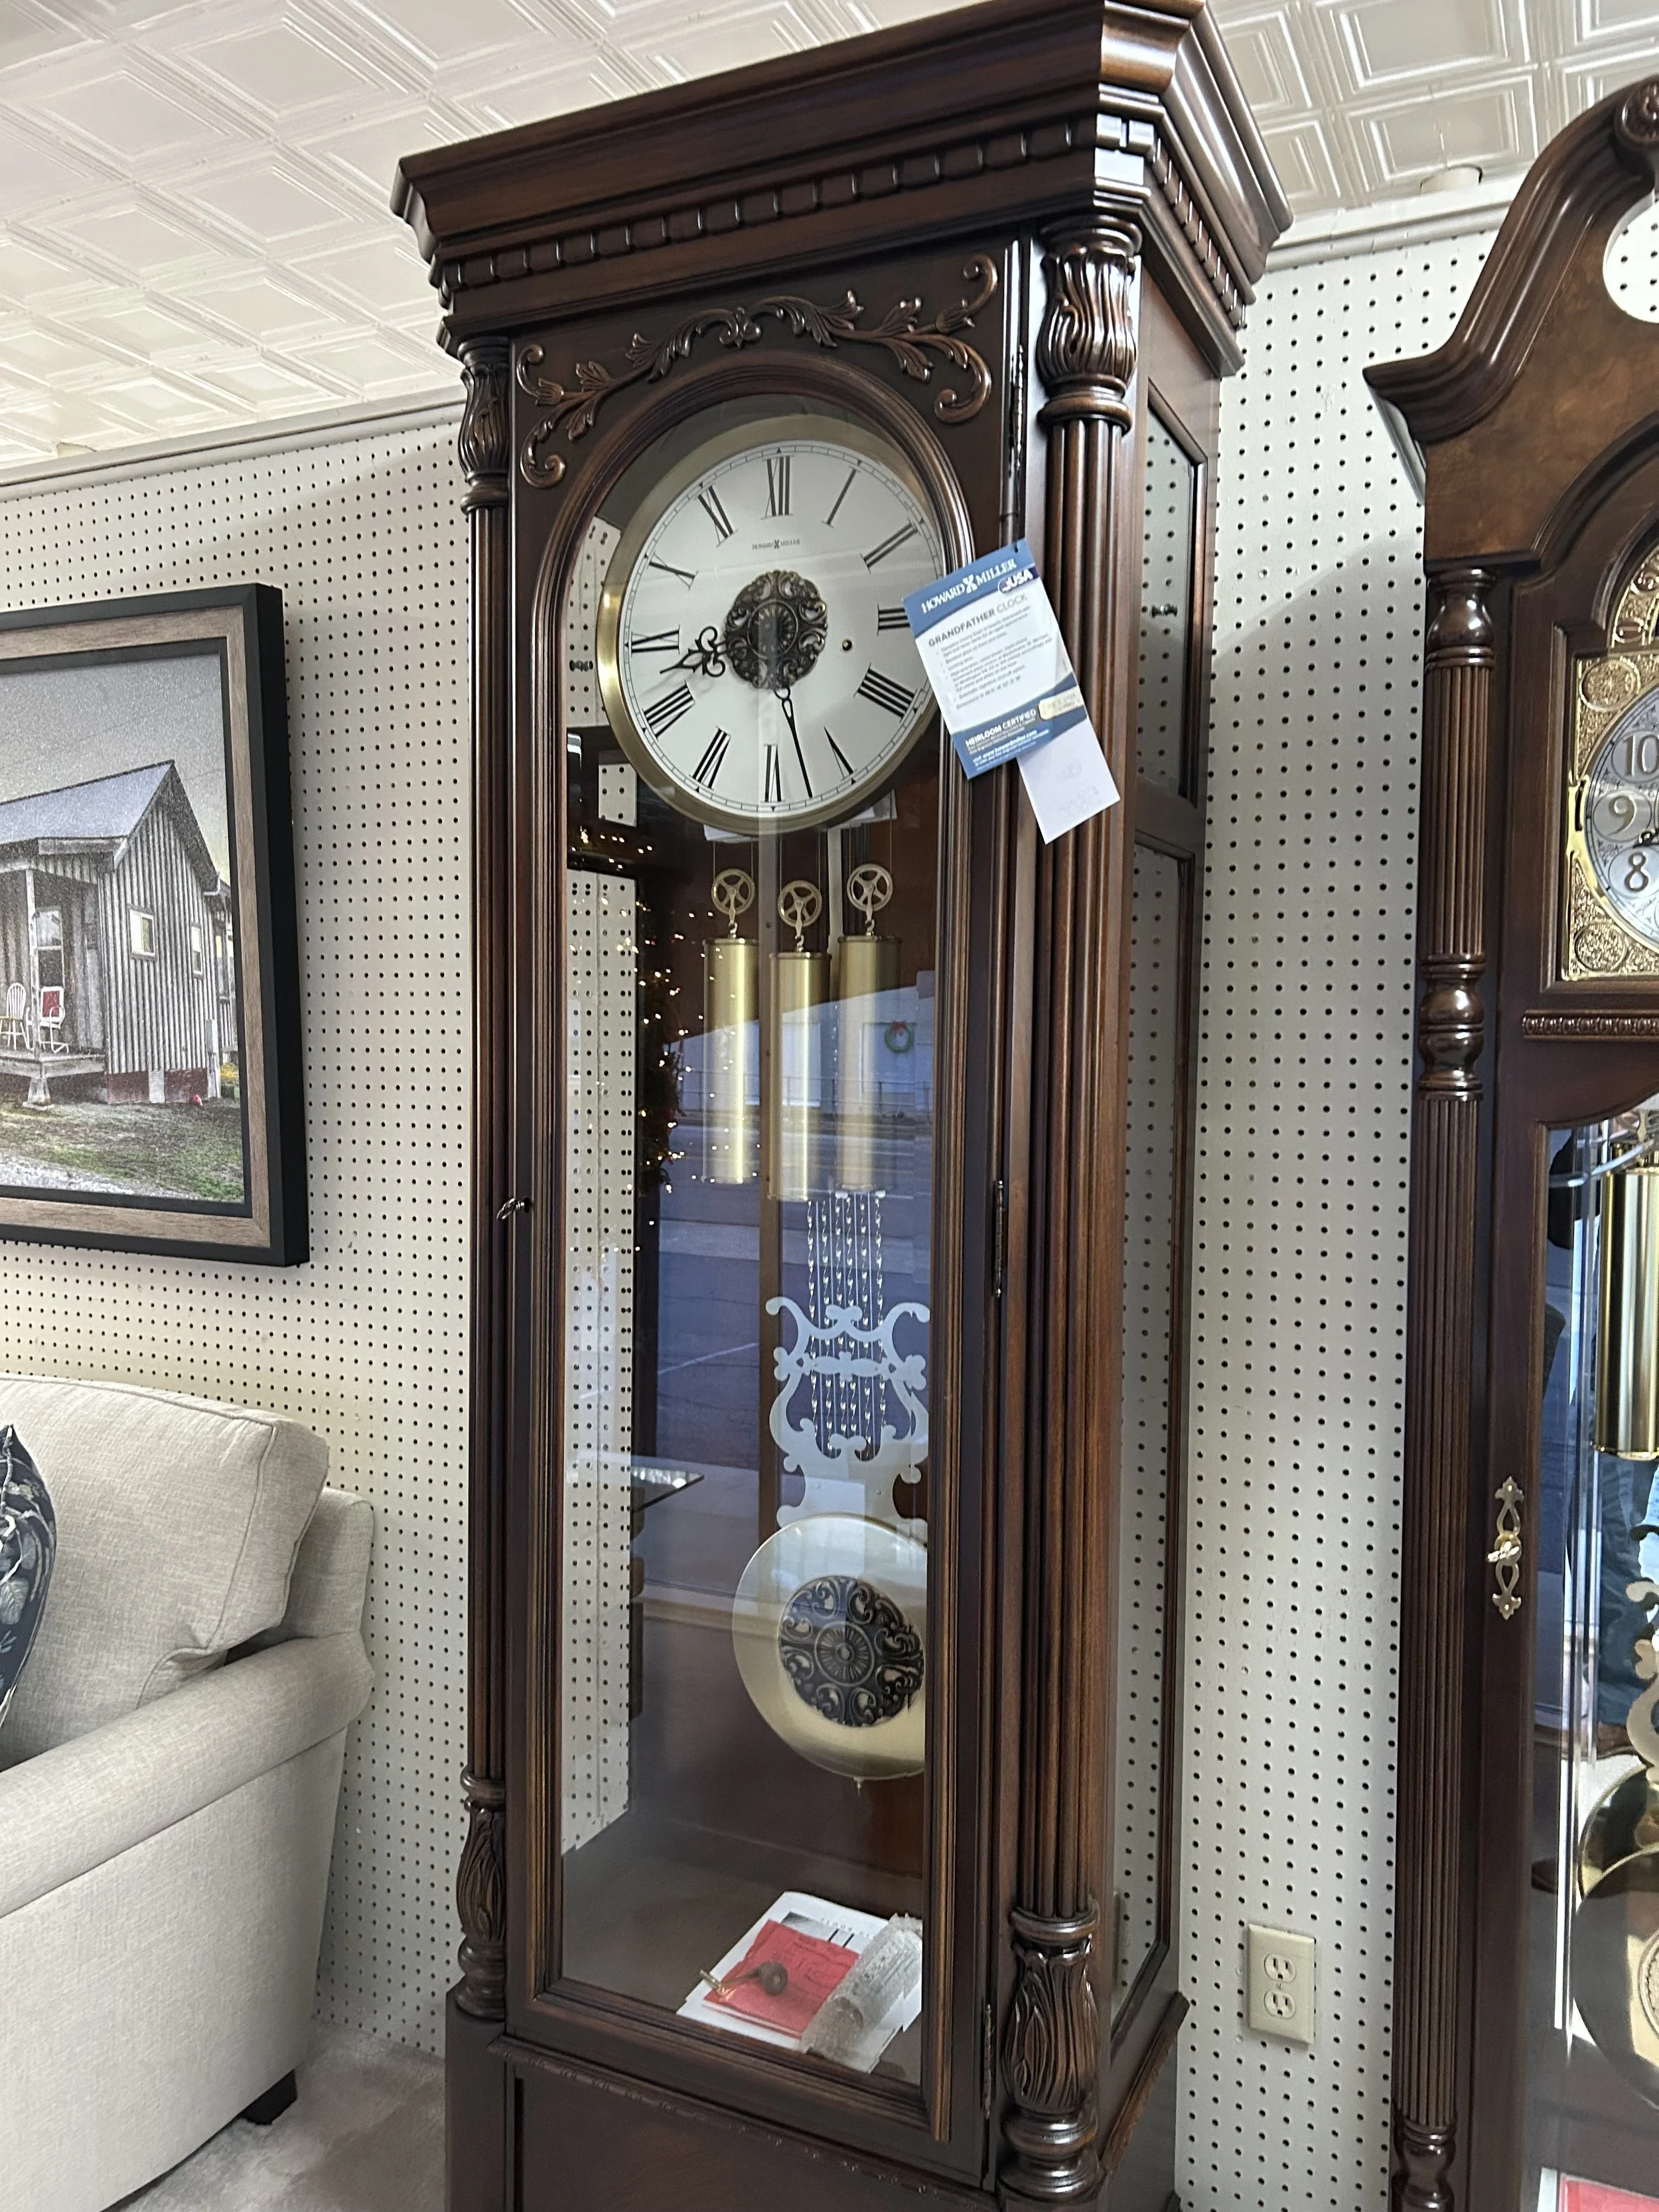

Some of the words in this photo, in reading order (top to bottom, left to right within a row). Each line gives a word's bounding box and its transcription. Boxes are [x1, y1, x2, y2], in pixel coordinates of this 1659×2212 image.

[760, 455, 794, 518] XII
[823, 466, 861, 528] I
[698, 484, 739, 547] XI
[649, 552, 698, 589] X
[861, 518, 922, 574] II
[922, 583, 965, 614] HOWARD
[975, 559, 1017, 586] MILLER
[1009, 569, 1033, 587] USA
[630, 625, 680, 655] IX
[929, 609, 995, 646] GRANDFATHER
[997, 593, 1028, 613] CLOCK
[643, 681, 695, 739] VIII
[853, 663, 920, 721] IIII
[824, 727, 858, 780] V
[966, 725, 1001, 747] HEIRLOOM
[1003, 708, 1037, 729] CERTIFIED
[691, 727, 731, 789] VII
[764, 744, 782, 803] VI
[1623, 735, 1659, 776] 10
[1609, 796, 1636, 835] 9
[1624, 852, 1649, 891] 8
